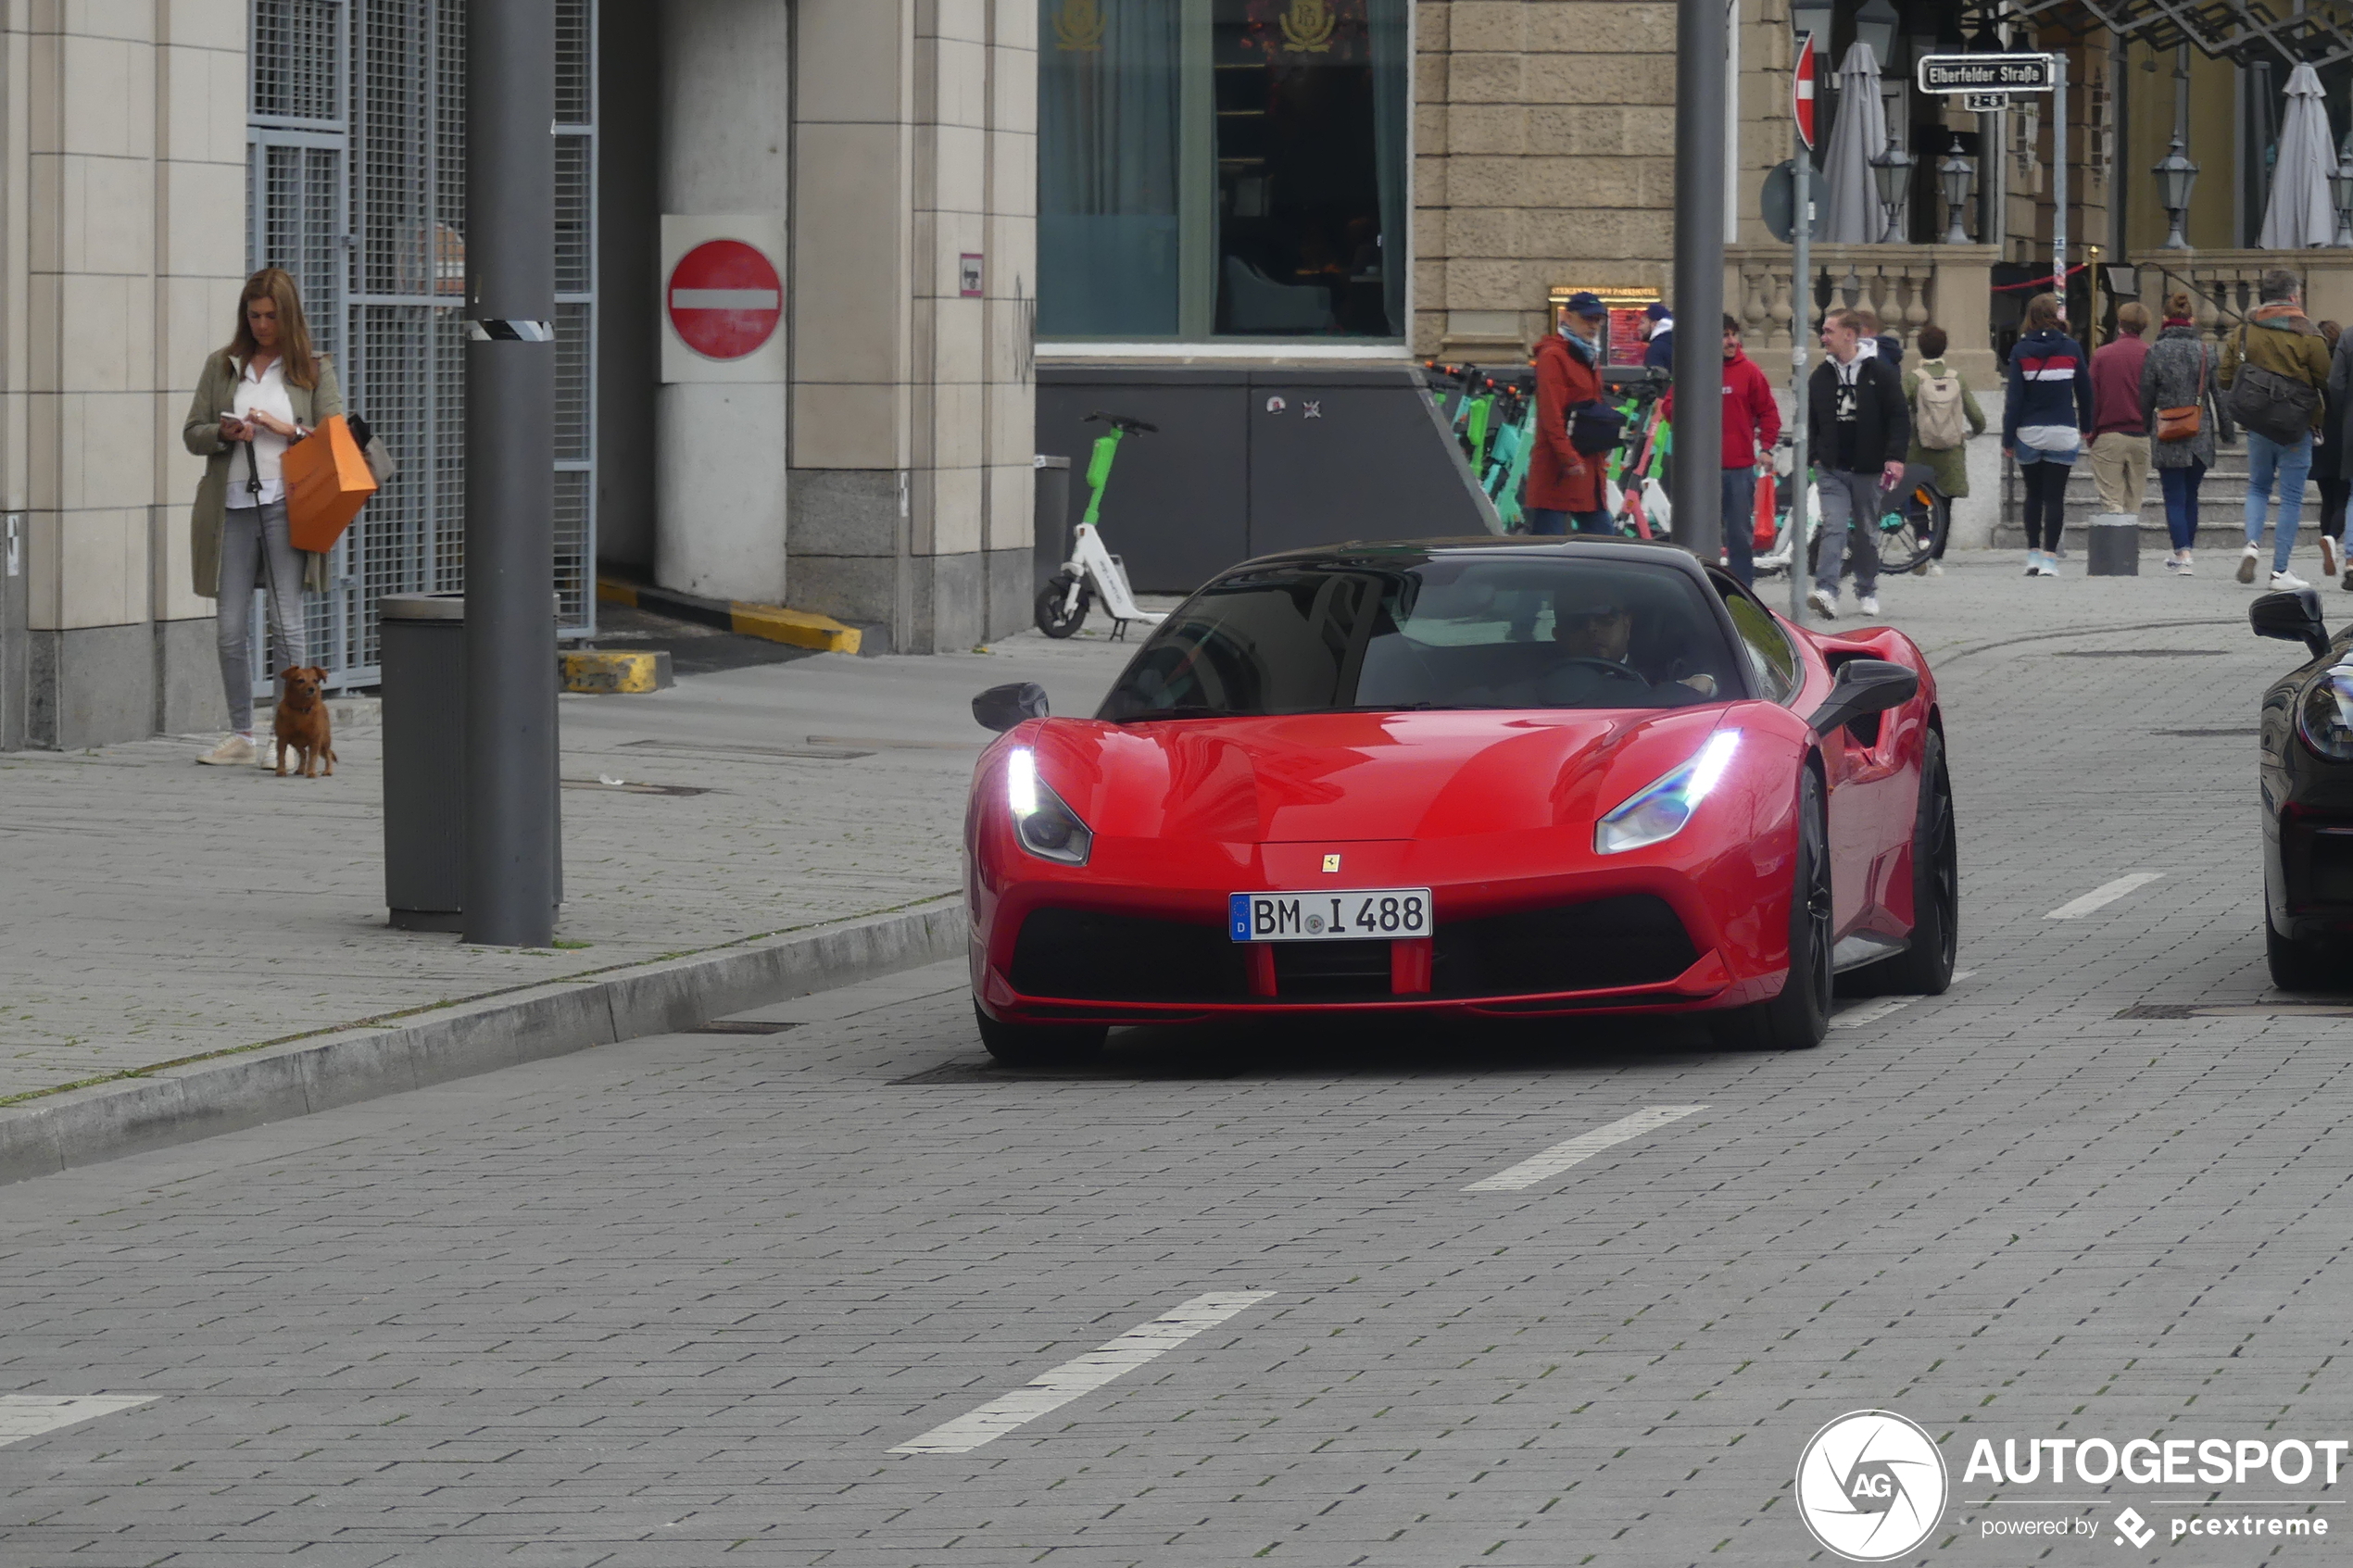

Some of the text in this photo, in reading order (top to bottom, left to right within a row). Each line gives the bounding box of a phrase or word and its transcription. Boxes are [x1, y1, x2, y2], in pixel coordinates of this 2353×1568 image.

[1929, 66, 2040, 83] Elberfelder Straße
[1254, 897, 1424, 935] BM I 488
[1237, 922, 1246, 933] D
